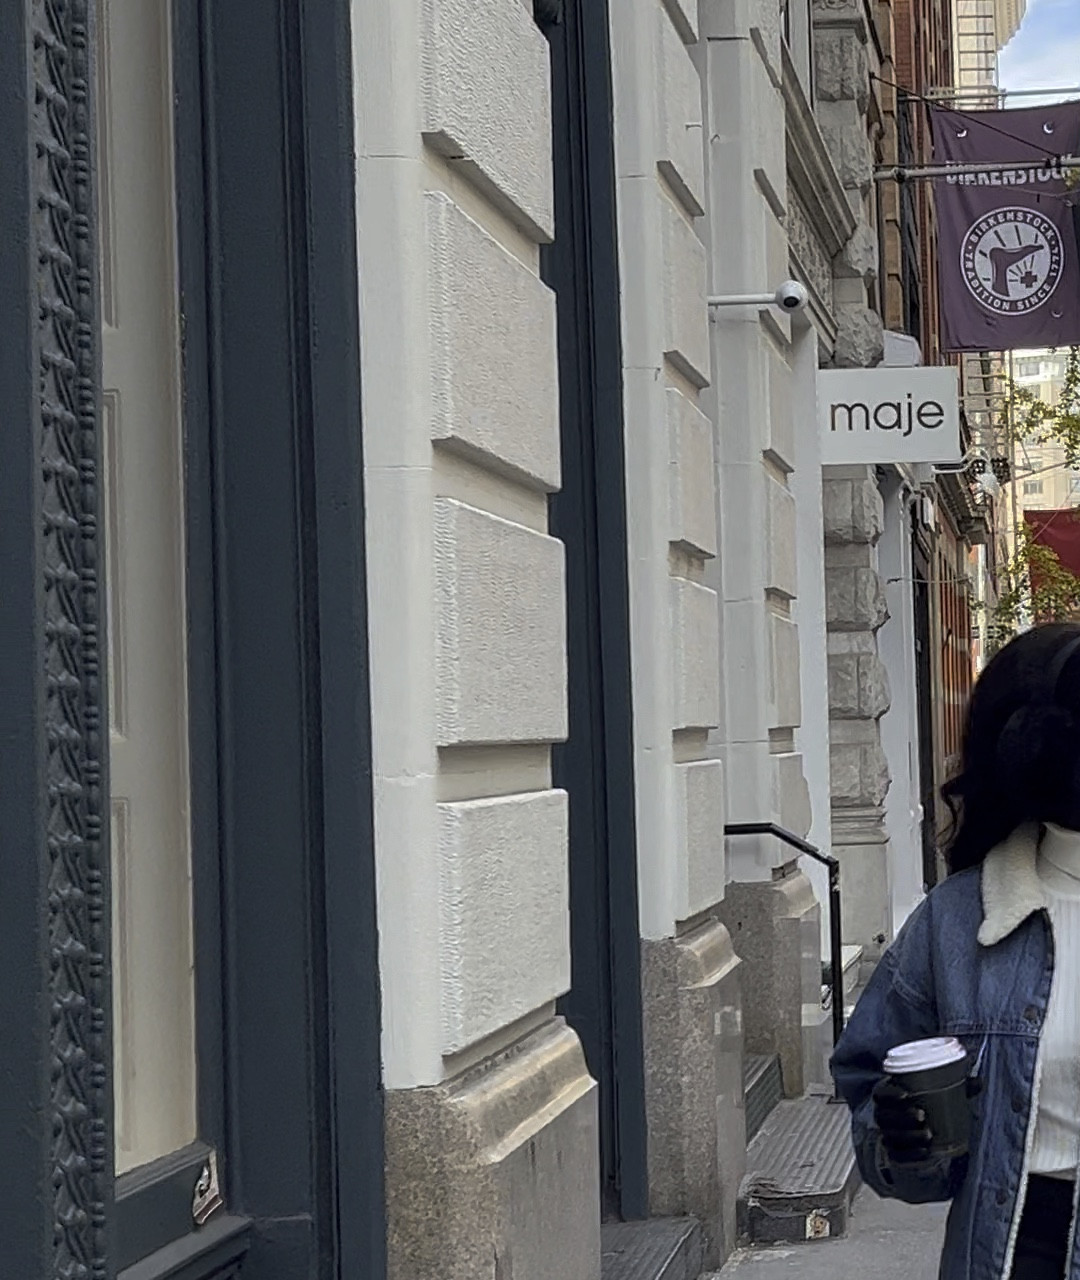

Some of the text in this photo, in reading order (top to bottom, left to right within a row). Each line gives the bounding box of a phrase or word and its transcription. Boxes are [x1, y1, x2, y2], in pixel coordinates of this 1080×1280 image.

[969, 211, 1054, 243] BIRKENSTOCK
[965, 247, 1060, 311] TRADITION SINCE 1774
[830, 393, 945, 437] maje
